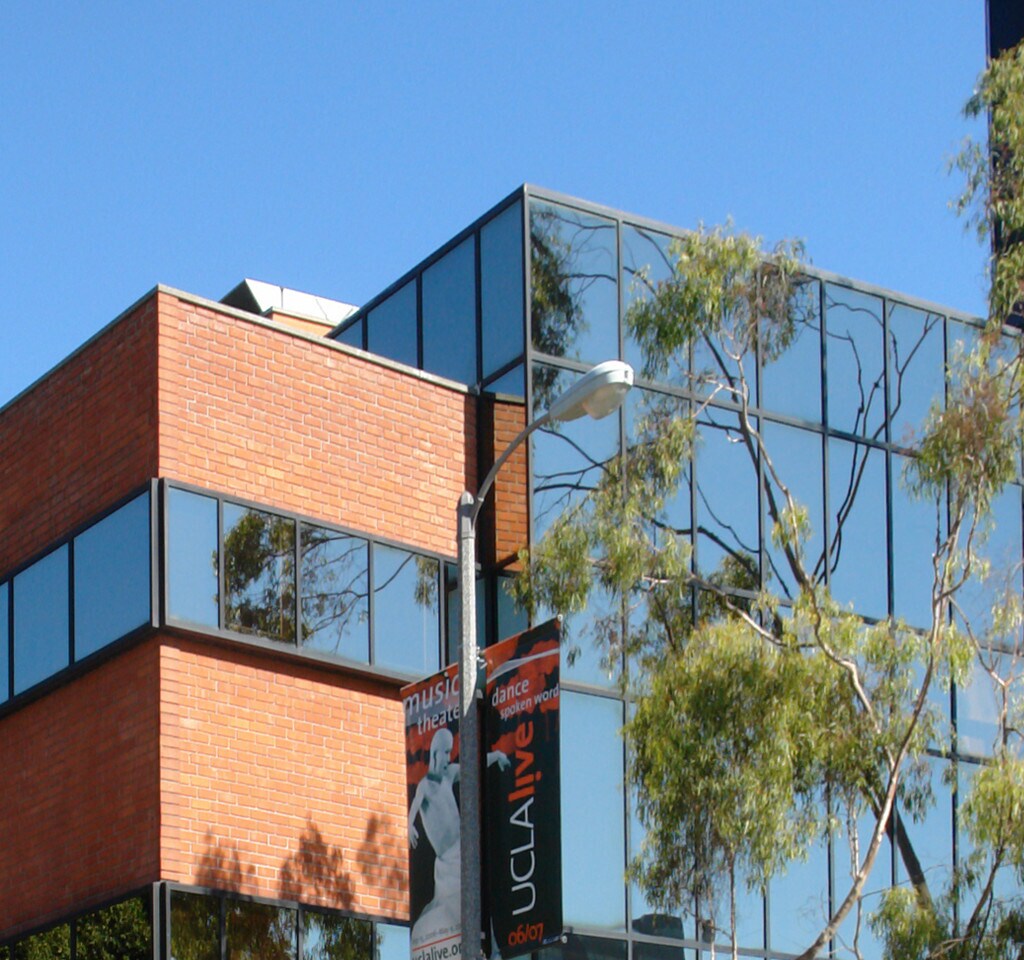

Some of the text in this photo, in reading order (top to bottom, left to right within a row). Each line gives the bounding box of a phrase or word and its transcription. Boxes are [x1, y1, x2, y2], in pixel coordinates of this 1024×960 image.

[402, 671, 460, 717] music
[491, 679, 529, 707] dance
[500, 683, 560, 722] spoken word
[416, 703, 460, 735] theate
[507, 922, 544, 948] 06/07
